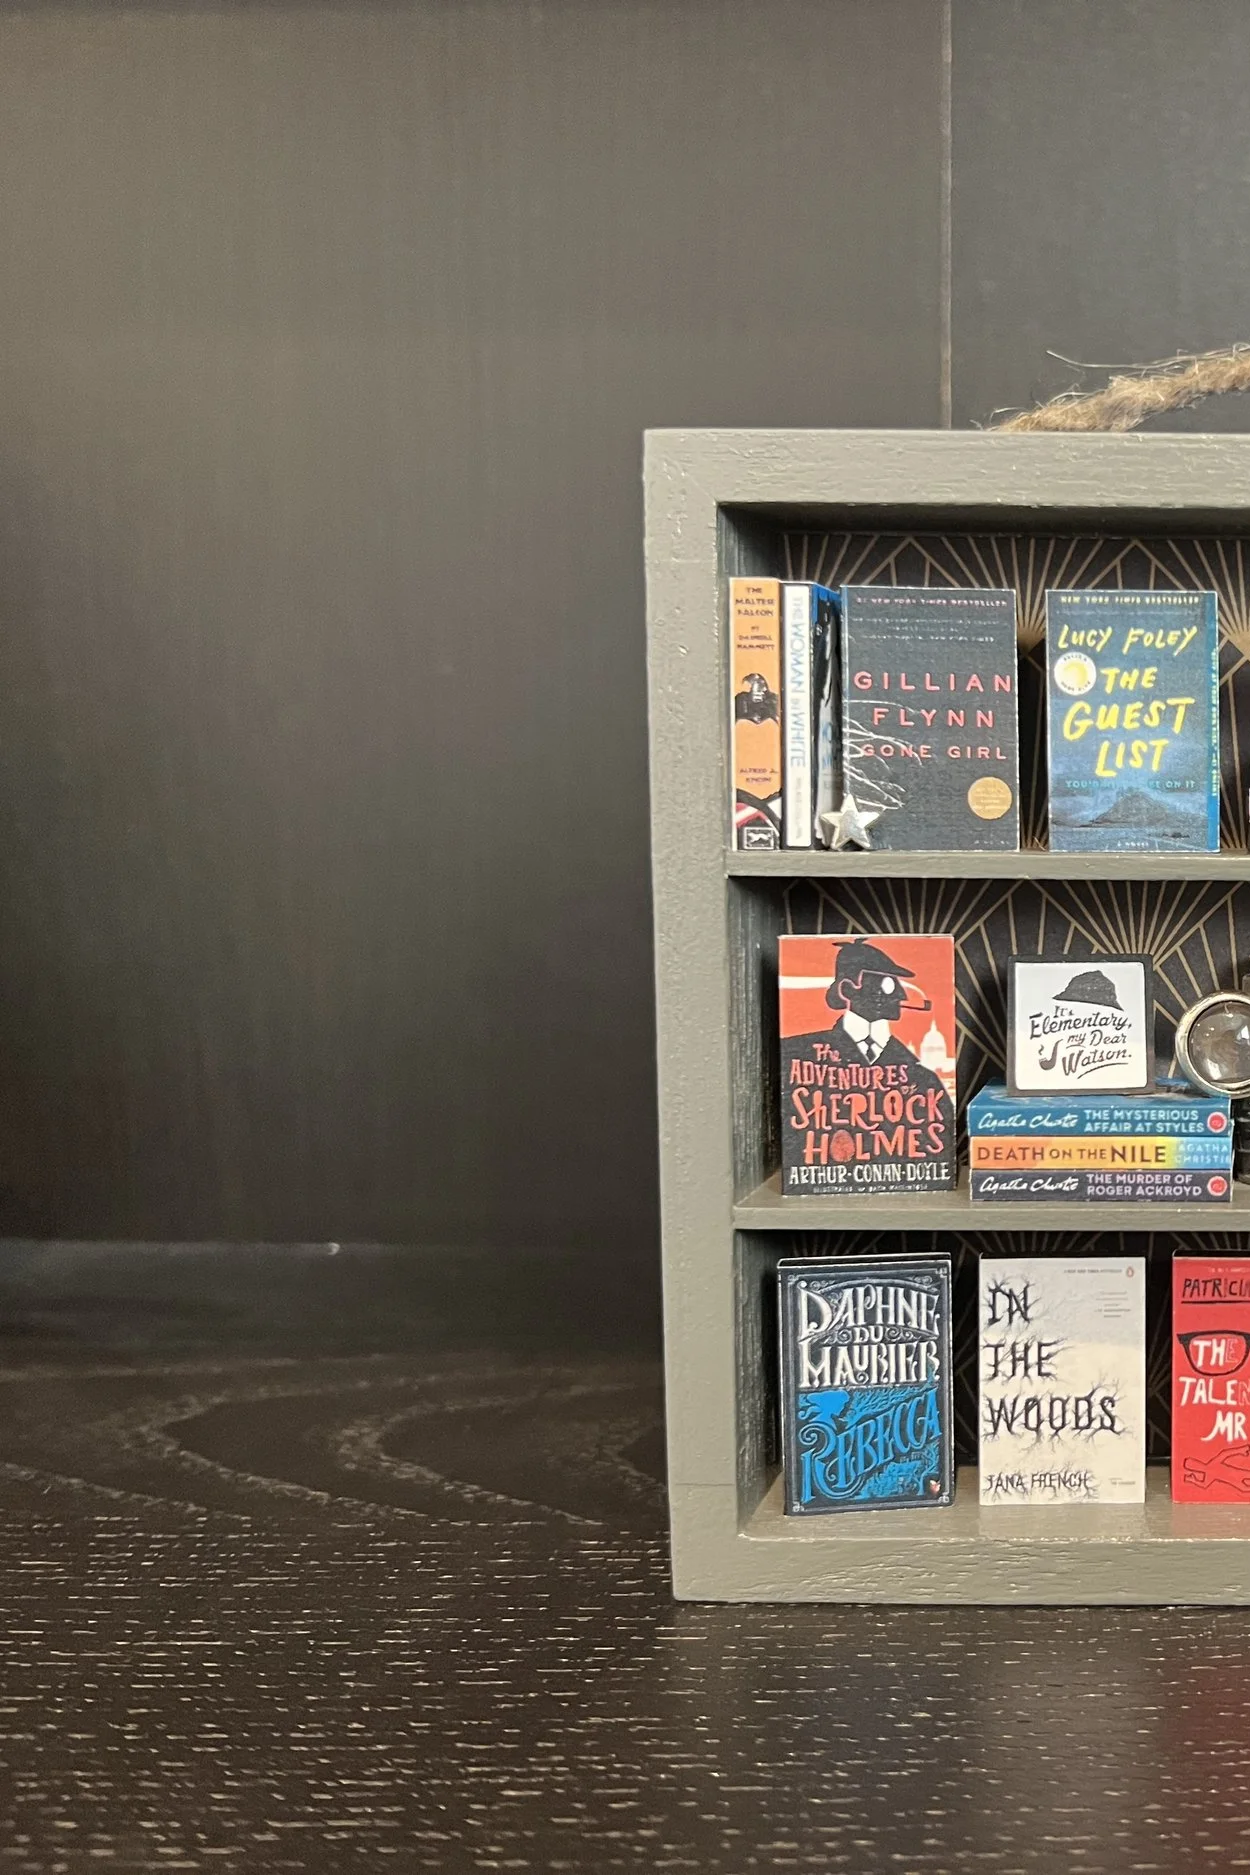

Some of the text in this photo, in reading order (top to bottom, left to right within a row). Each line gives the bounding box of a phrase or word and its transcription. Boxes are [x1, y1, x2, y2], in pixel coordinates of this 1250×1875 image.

[1058, 624, 1198, 657] LUCY FOLEY
[790, 621, 805, 693] WOMAN
[853, 671, 1012, 692] GILLIAN
[1100, 666, 1158, 694] THE
[872, 708, 995, 728] FLYNN
[1063, 697, 1196, 742] GUEST
[790, 711, 806, 768] WHITE
[860, 744, 1008, 760] GONE GIRL
[1095, 739, 1170, 778] LIST
[1029, 1012, 1132, 1040] Elementary,
[1066, 1029, 1127, 1046] my Dear
[812, 1043, 842, 1064] The
[1061, 1049, 1132, 1076] Watson.
[790, 1059, 908, 1092] ADVENTURES
[1084, 1110, 1110, 1121] THE
[1114, 1110, 1200, 1122] MYSTERIOUS
[1084, 1122, 1204, 1133] AFFAIR AT STYLES
[803, 1122, 946, 1166] HOLMES
[977, 1145, 1166, 1163] DEATH ON THE NILE
[1179, 1144, 1228, 1152] AGATHA
[1086, 1174, 1112, 1184] THE
[1116, 1174, 1170, 1184] MURDER
[1174, 1174, 1192, 1184] OF
[1086, 1184, 1202, 1196] ROGER ACKROYD
[799, 1281, 941, 1339] DAPHNE
[983, 1282, 1033, 1327] IN
[852, 1325, 884, 1344] DU
[800, 1339, 941, 1388] MAURIER
[983, 1338, 1061, 1380] THE
[1192, 1337, 1240, 1367] THE
[983, 1392, 1125, 1438] WOODS
[1201, 1411, 1247, 1442] MR
[799, 1387, 943, 1504] REBECCA
